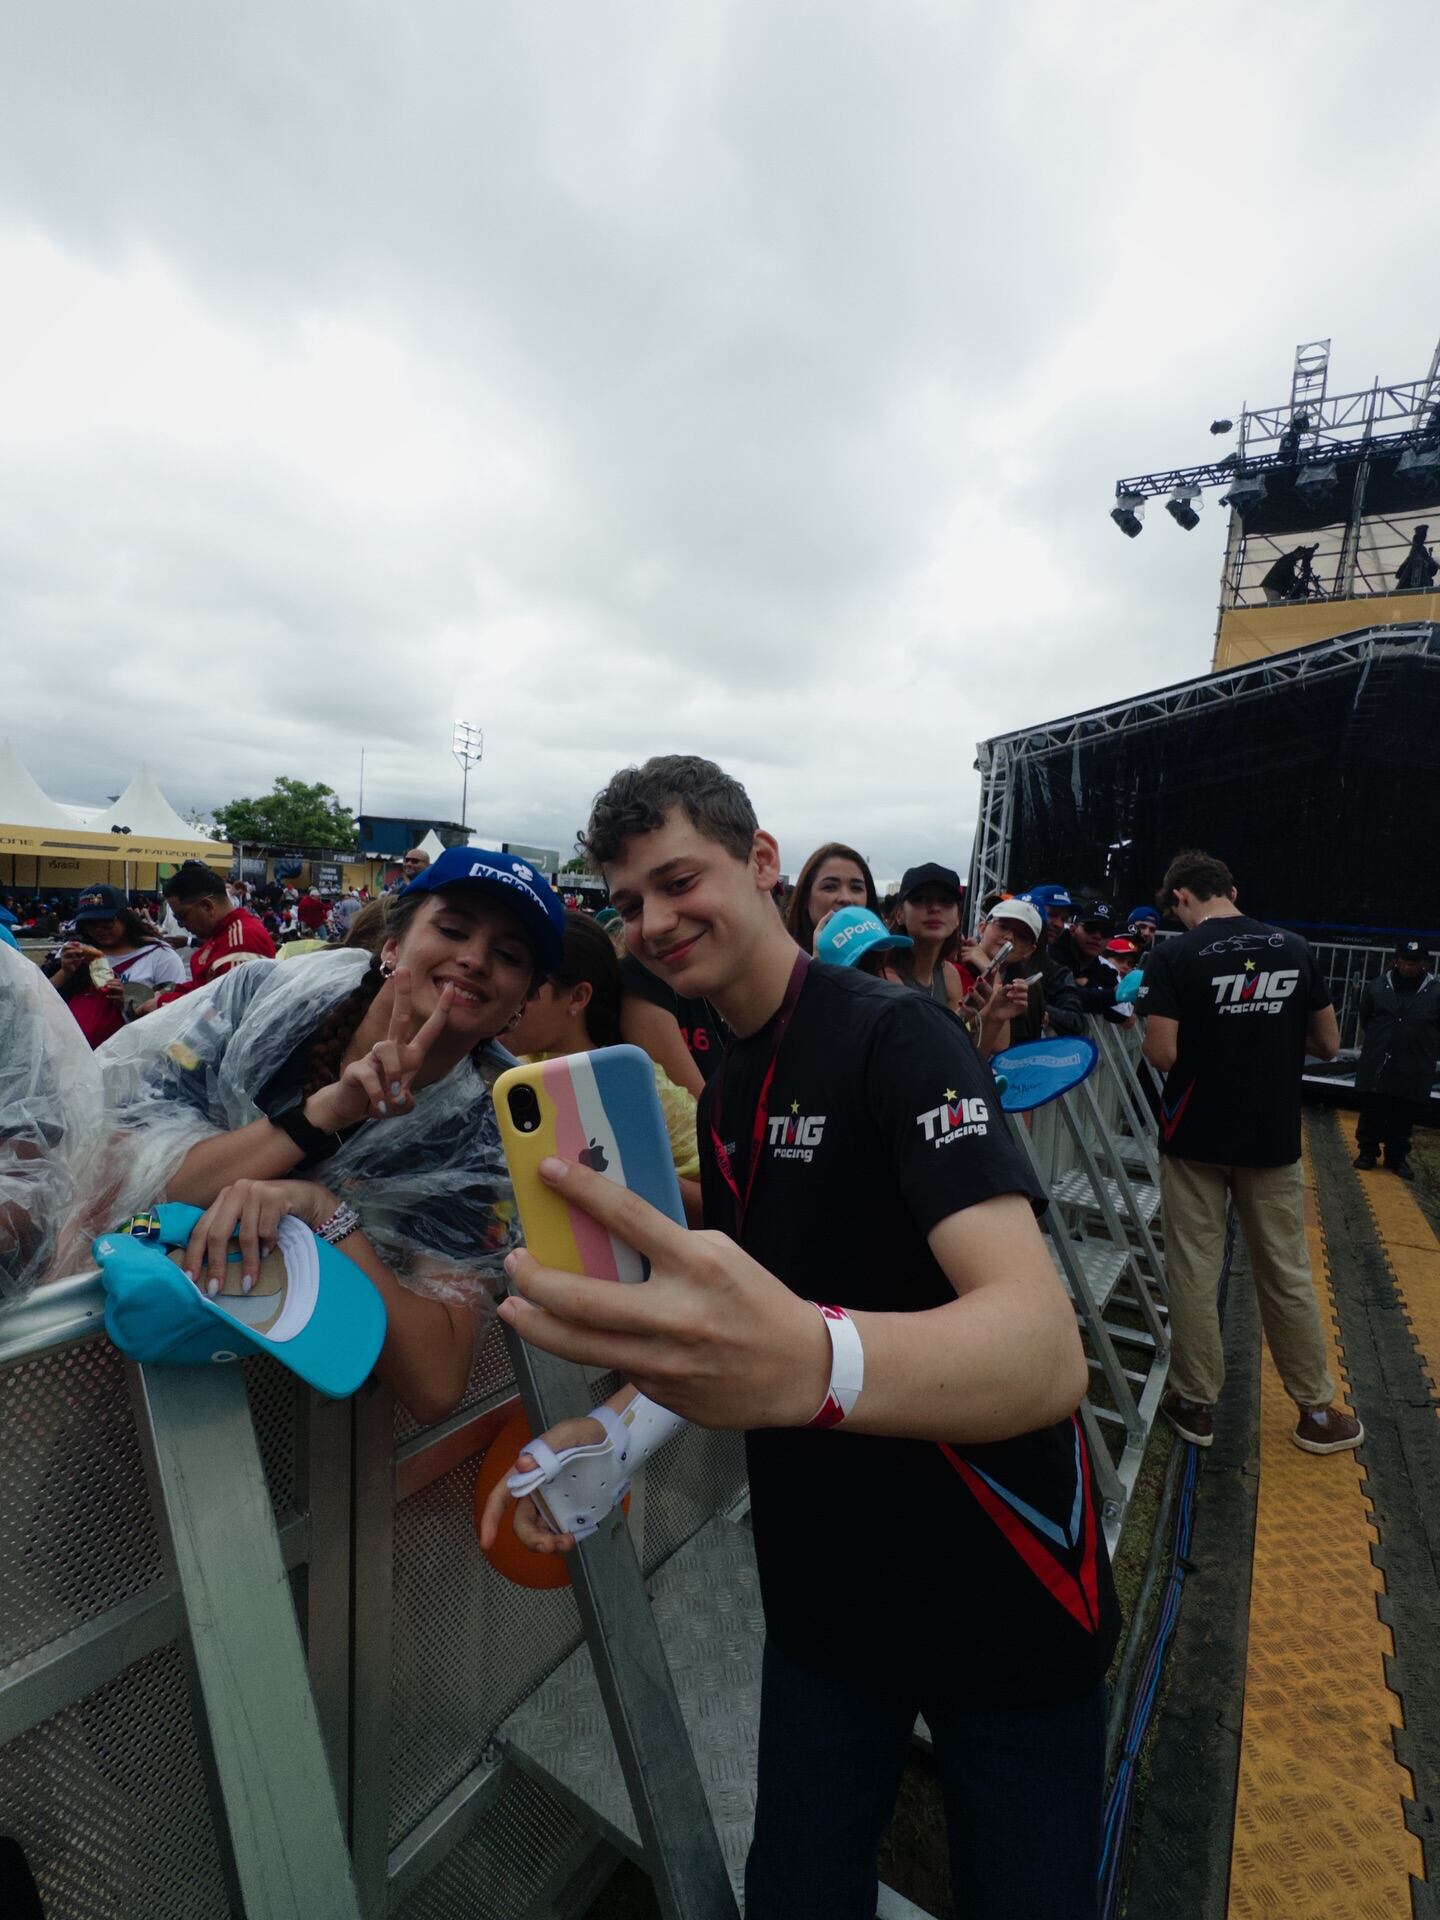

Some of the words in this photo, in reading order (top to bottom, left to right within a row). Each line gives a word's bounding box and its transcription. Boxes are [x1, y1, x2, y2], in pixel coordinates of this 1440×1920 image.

[1211, 969, 1300, 1005] TMG
[1218, 1000, 1284, 1015] racing
[767, 1115, 827, 1146] TMG
[916, 1097, 989, 1141] TMG
[935, 1123, 988, 1149] racing
[773, 1148, 815, 1163] racing
